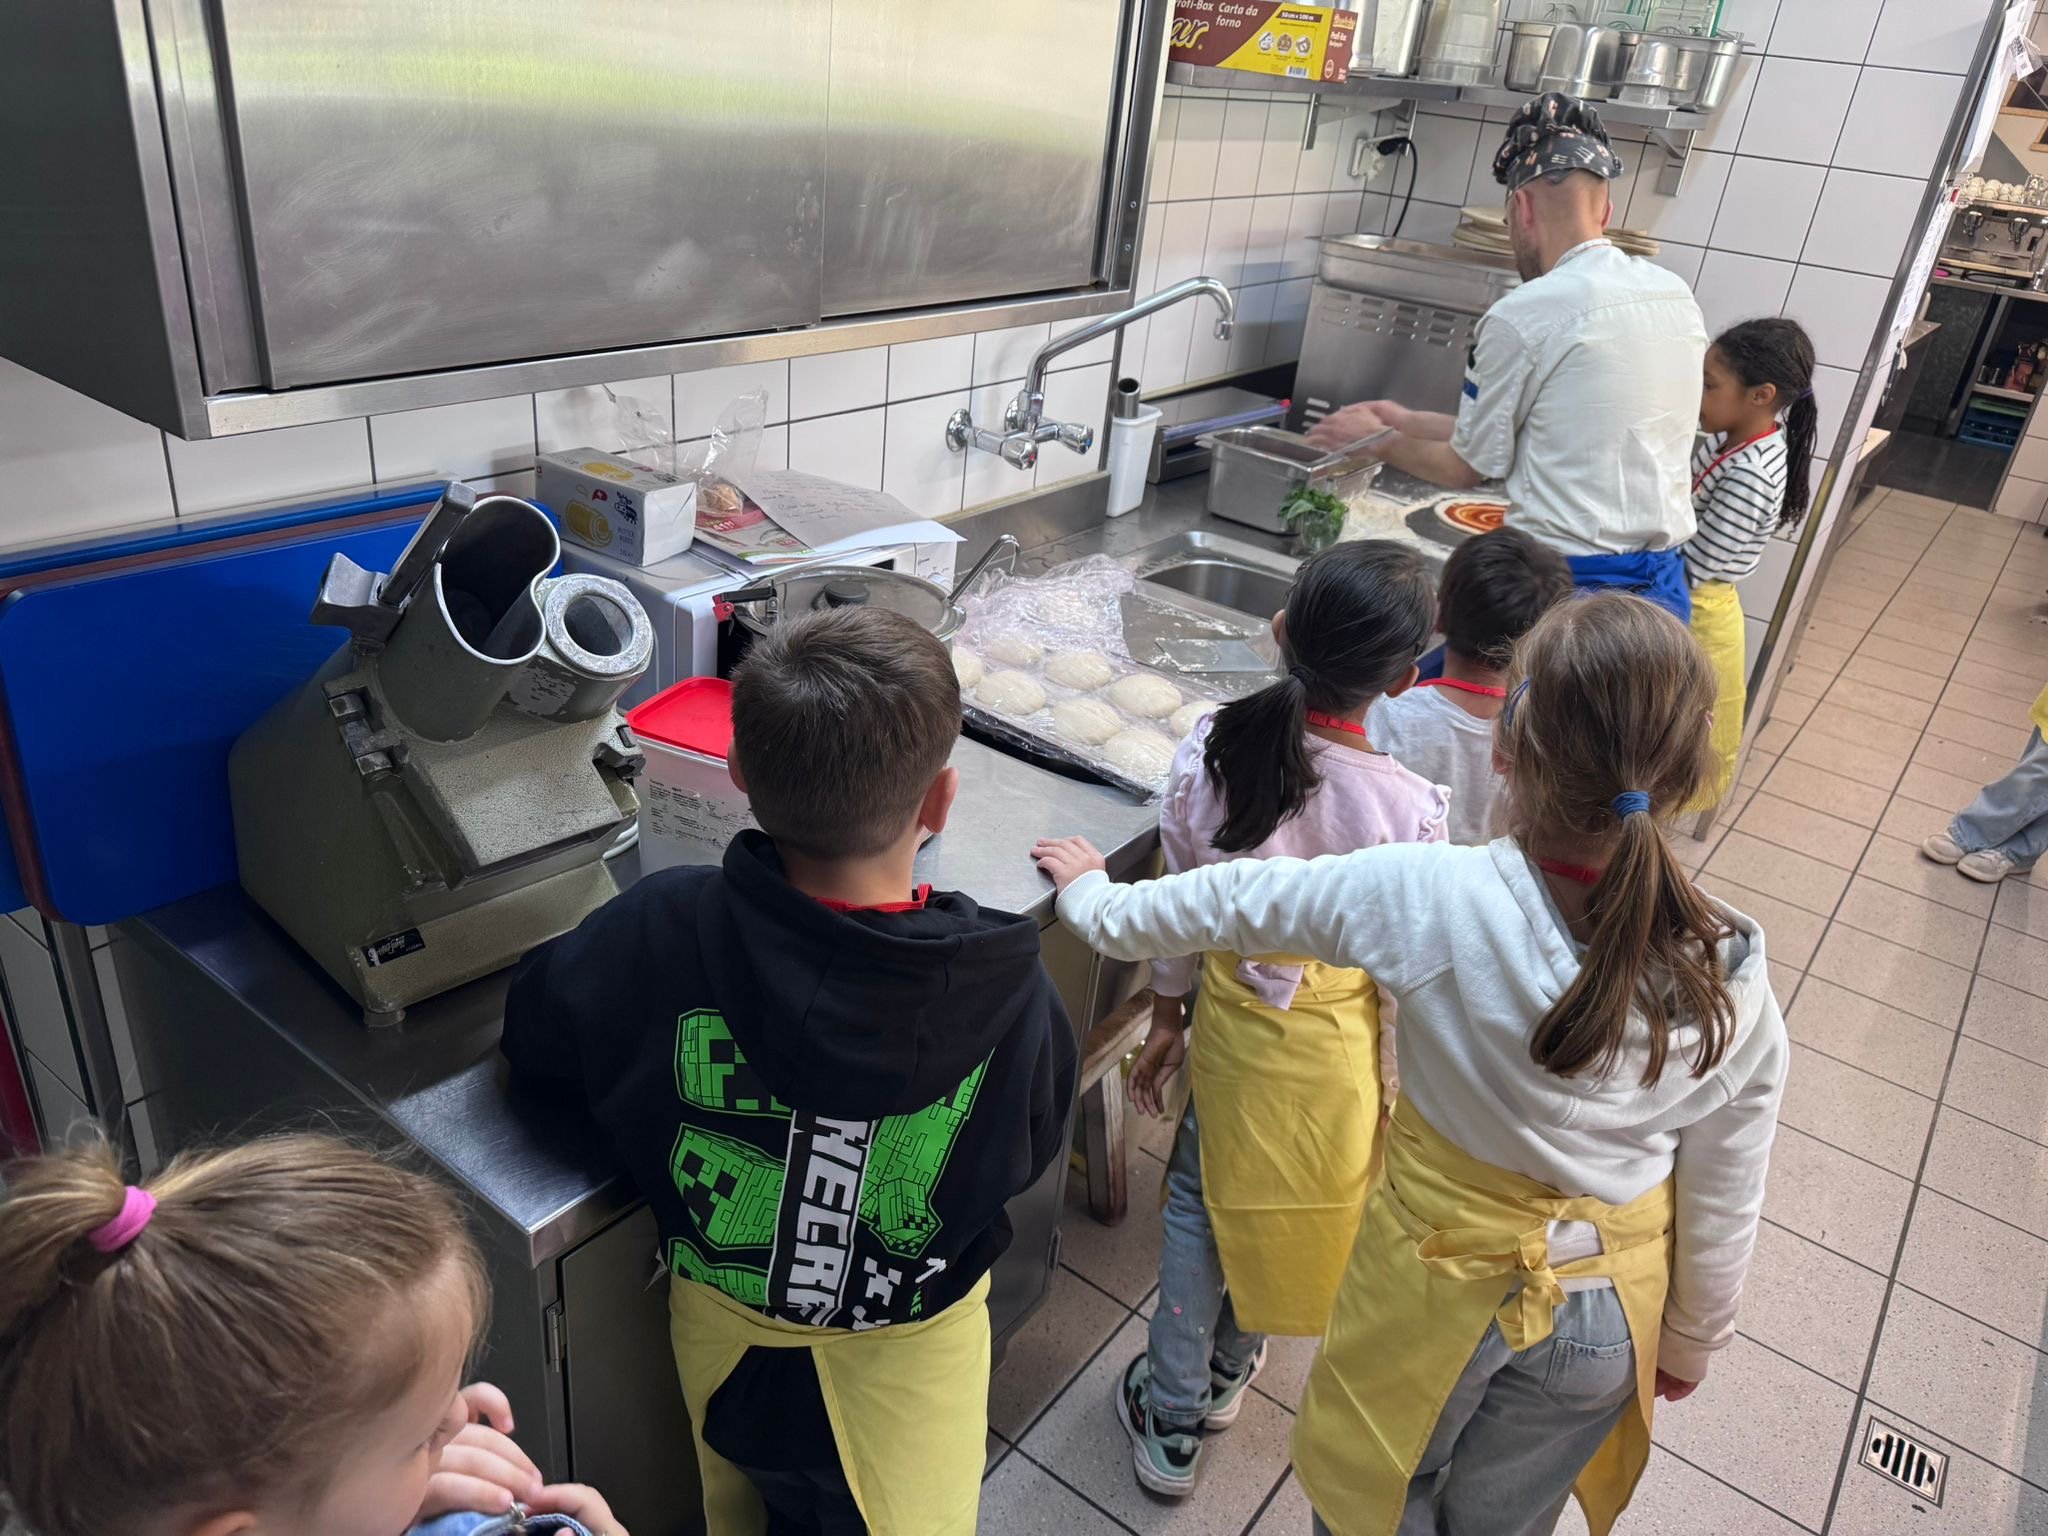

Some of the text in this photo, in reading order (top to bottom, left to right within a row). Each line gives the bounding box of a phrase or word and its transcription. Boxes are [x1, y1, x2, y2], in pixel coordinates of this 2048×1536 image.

[1175, 0, 1215, 11] rofi-Box
[1218, 2, 1259, 16] Carta da
[1216, 15, 1242, 28] forno
